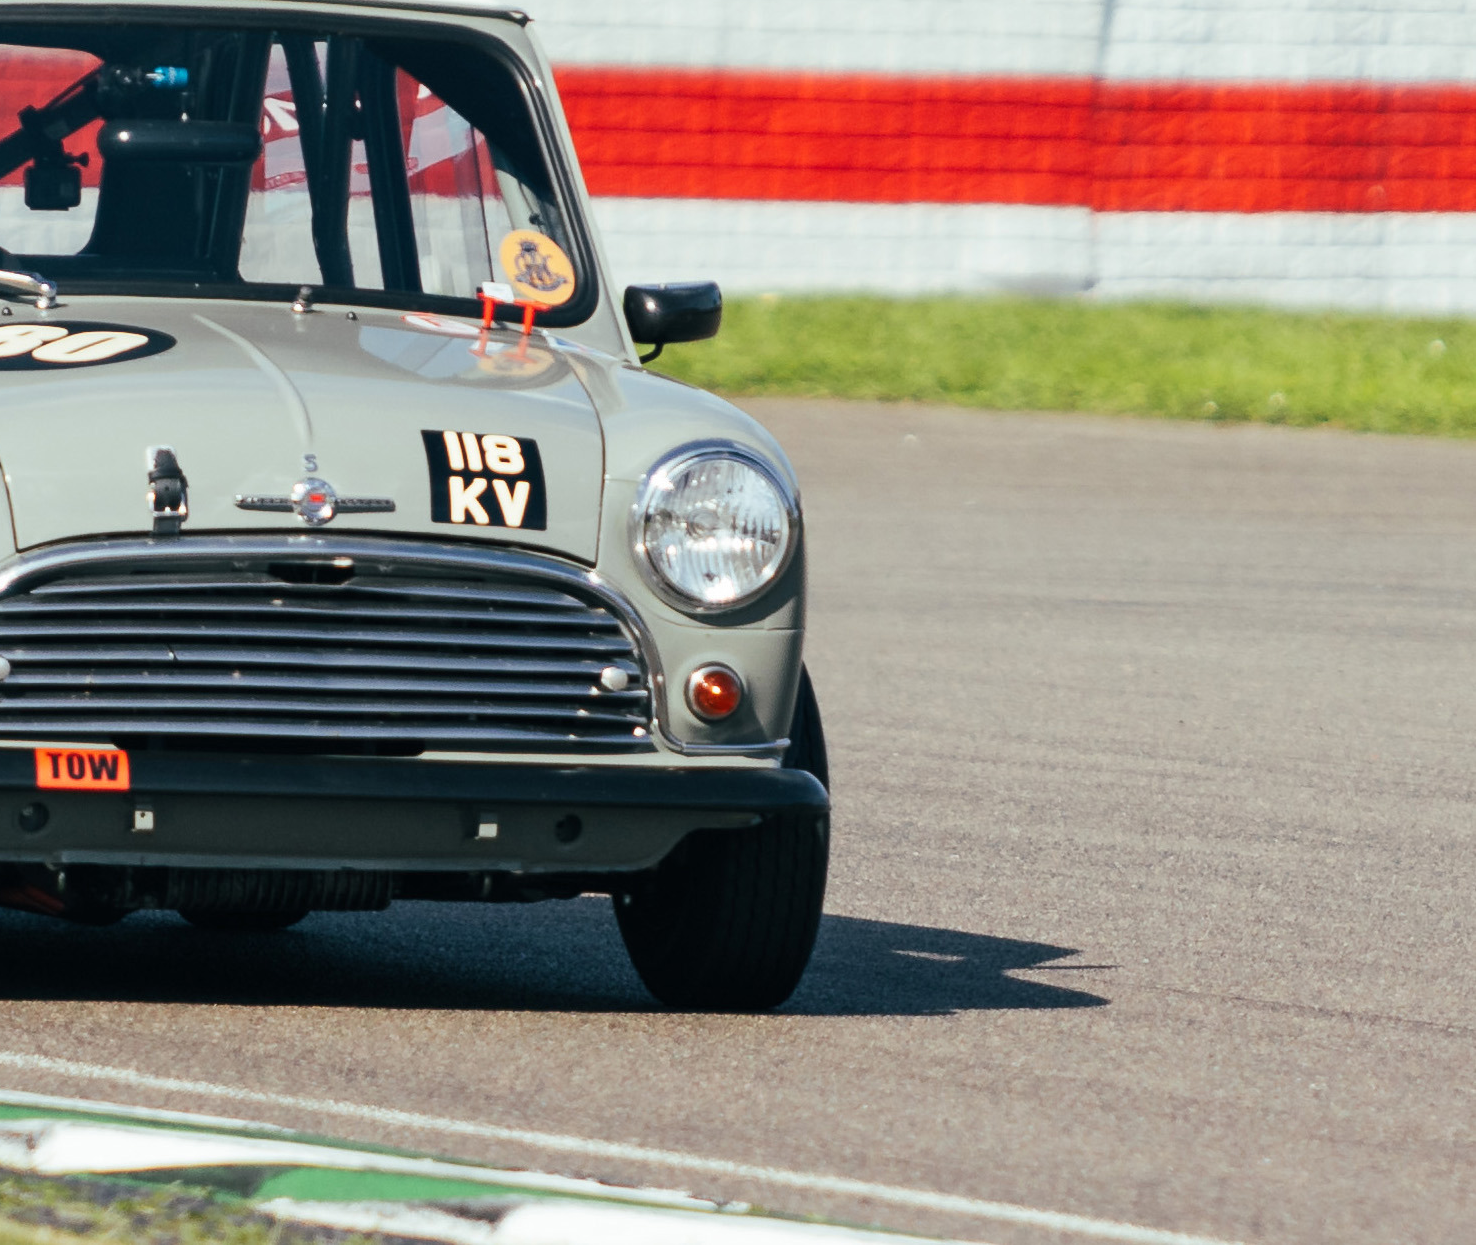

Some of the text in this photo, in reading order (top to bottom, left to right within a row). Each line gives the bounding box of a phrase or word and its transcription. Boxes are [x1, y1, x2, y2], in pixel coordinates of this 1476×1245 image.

[442, 430, 525, 475] 118
[449, 475, 530, 528] KV
[46, 752, 119, 781] TOW
